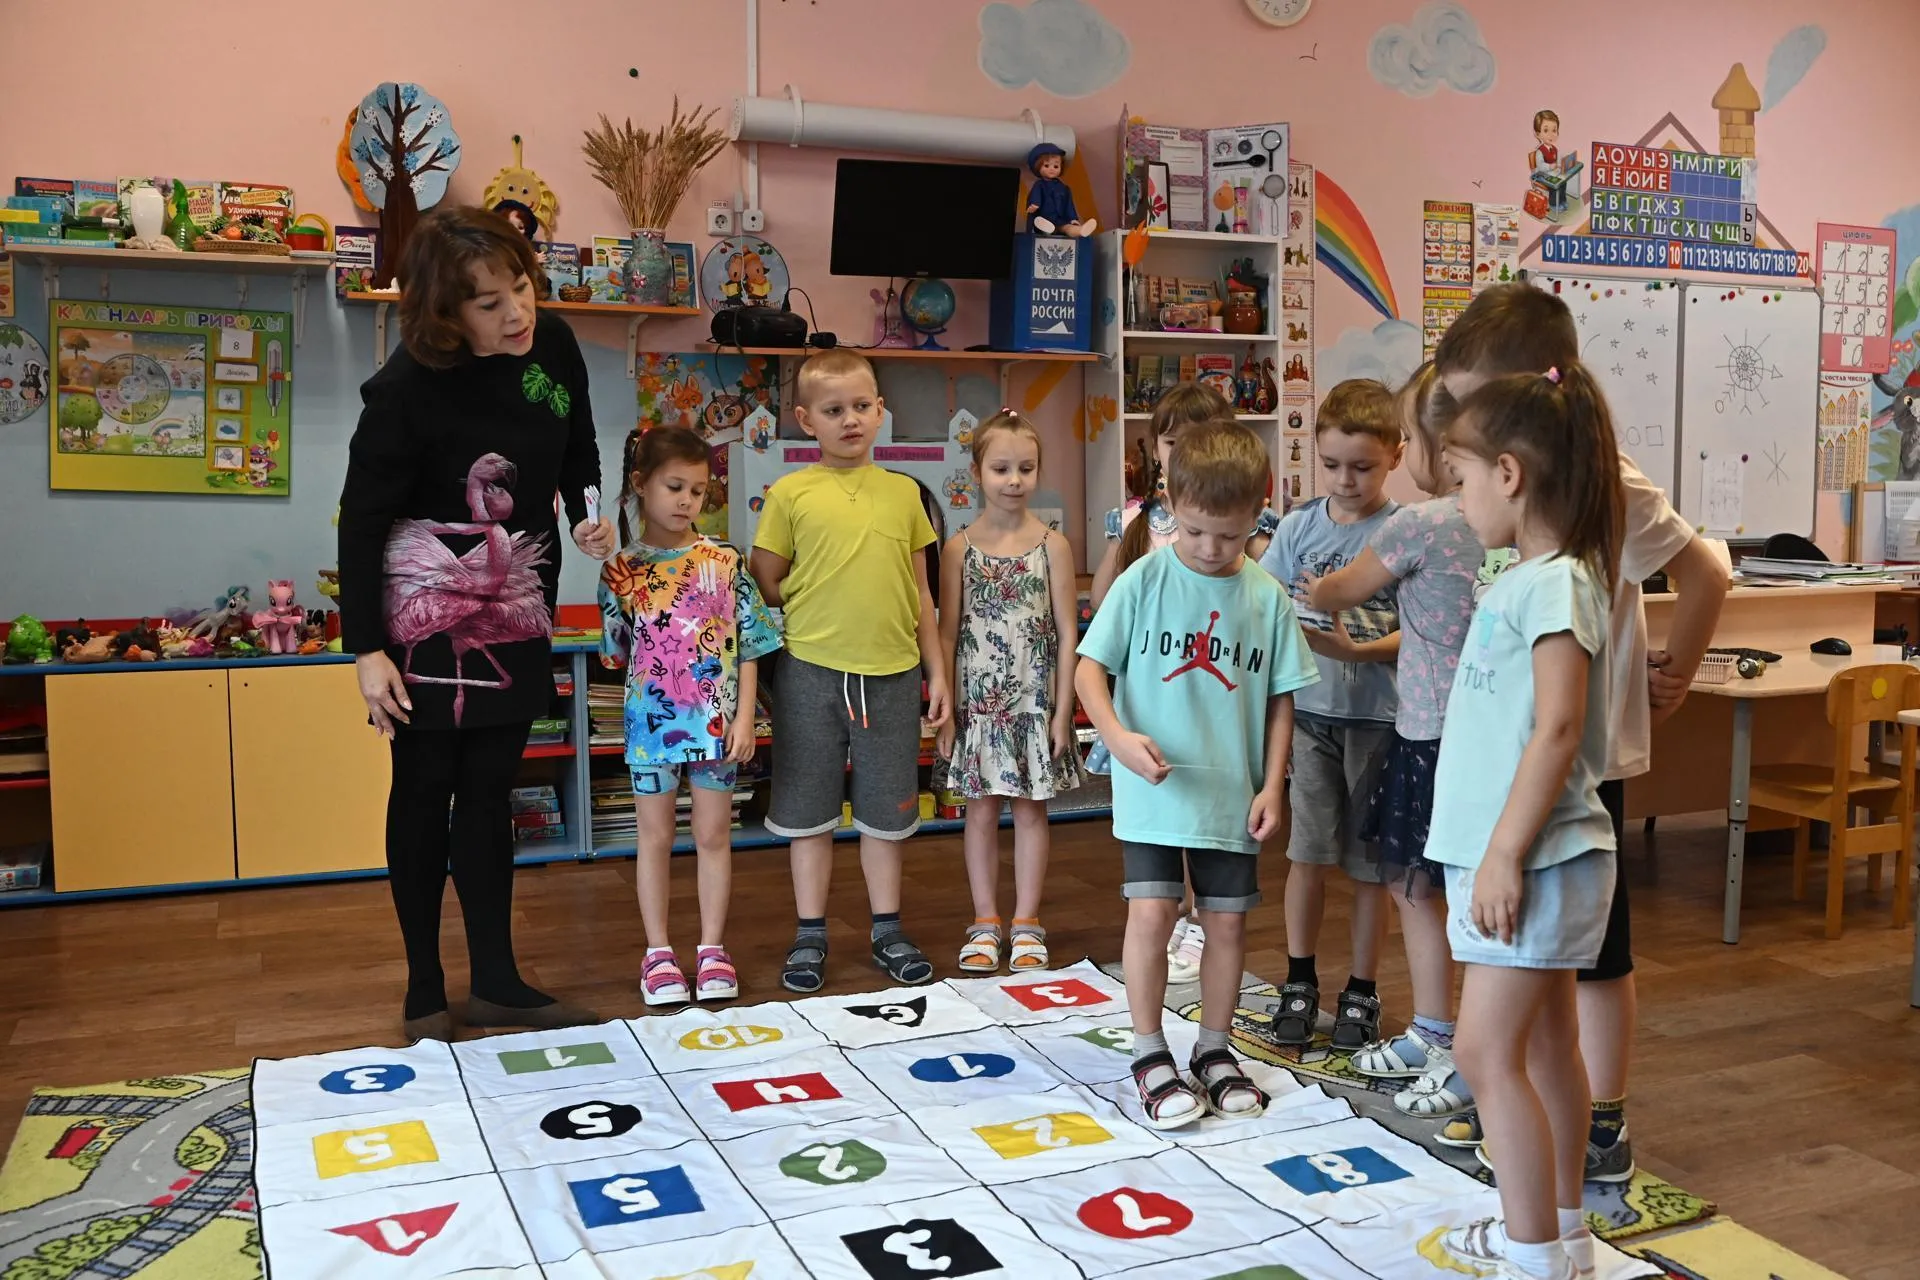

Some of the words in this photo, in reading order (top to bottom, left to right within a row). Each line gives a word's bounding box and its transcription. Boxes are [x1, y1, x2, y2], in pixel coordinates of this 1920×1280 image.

[1842, 232, 1872, 240] ЦИФРЫ
[1546, 238, 1554, 258] 0
[1559, 240, 1564, 258] 1
[1572, 240, 1579, 259] 2
[1584, 241, 1592, 260] 3
[1597, 242, 1605, 260] 4
[1610, 242, 1617, 260] 5
[1622, 244, 1630, 262] 6
[1634, 244, 1642, 262] 7
[1646, 244, 1654, 262] 8
[1659, 246, 1666, 264] 9
[1670, 246, 1680, 264] 10
[1684, 248, 1692, 266] 11
[1696, 248, 1706, 266] 12
[1710, 249, 1720, 267] 13
[1722, 250, 1733, 268] 14
[1736, 251, 1746, 269] 15
[1748, 252, 1758, 270] 16
[1760, 252, 1771, 271] 17
[1774, 254, 1784, 272] 18
[1786, 254, 1796, 272] 19
[1798, 256, 1808, 274] 20
[1836, 248, 1846, 272] 1
[1858, 250, 1867, 274] 2
[1879, 253, 1889, 276] 3
[1032, 288, 1074, 302] ПОЧТА
[1834, 280, 1844, 303] 4
[1856, 281, 1866, 305] 5
[1876, 284, 1888, 306] 6
[57, 304, 180, 326] КАЛЕНДАРЬ
[184, 312, 284, 332] ПРИРОДЫ
[1031, 305, 1075, 320] РОССИИ
[1834, 311, 1842, 334] 7
[1854, 312, 1865, 336] 8
[1876, 314, 1886, 337] 9
[233, 341, 240, 351] 8
[1852, 344, 1863, 366] 0
[701, 546, 732, 564] MIN
[1140, 630, 1264, 674] JORDAN
[1032, 985, 1079, 1006] 3
[697, 1025, 771, 1048] 10
[544, 1048, 579, 1067] 1
[946, 1055, 986, 1078] 1
[344, 1067, 388, 1092] 3
[754, 1080, 810, 1103] 4
[568, 1104, 613, 1136] 5
[1012, 1117, 1070, 1148] 2
[342, 1131, 394, 1164] 5
[800, 1144, 859, 1179] 2
[1307, 1152, 1368, 1185] 8
[601, 1177, 661, 1214] 5
[882, 1229, 952, 1271] 3
